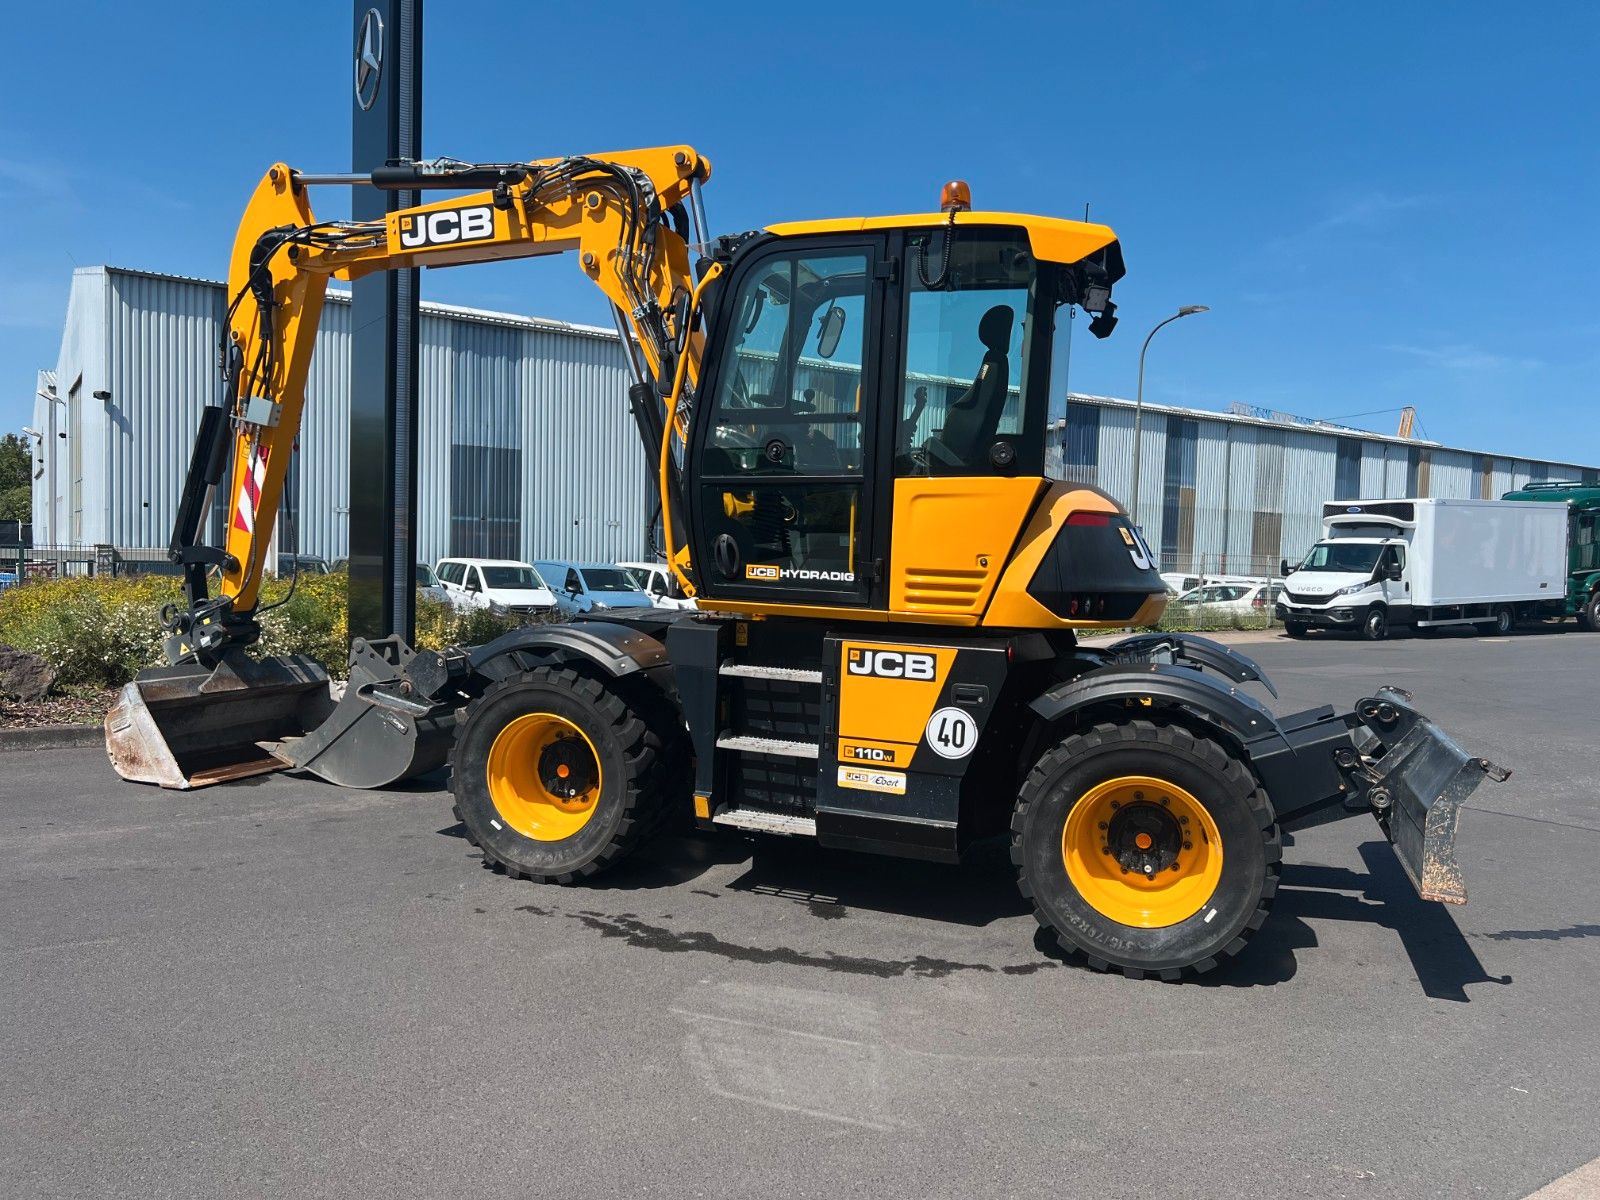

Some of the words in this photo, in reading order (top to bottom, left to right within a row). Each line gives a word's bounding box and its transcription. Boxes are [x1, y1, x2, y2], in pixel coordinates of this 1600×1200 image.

[401, 207, 493, 247] JCB
[748, 567, 777, 578] JCB
[780, 568, 855, 582] HYDRADIG
[849, 650, 934, 680] JCB
[937, 717, 966, 749] 40
